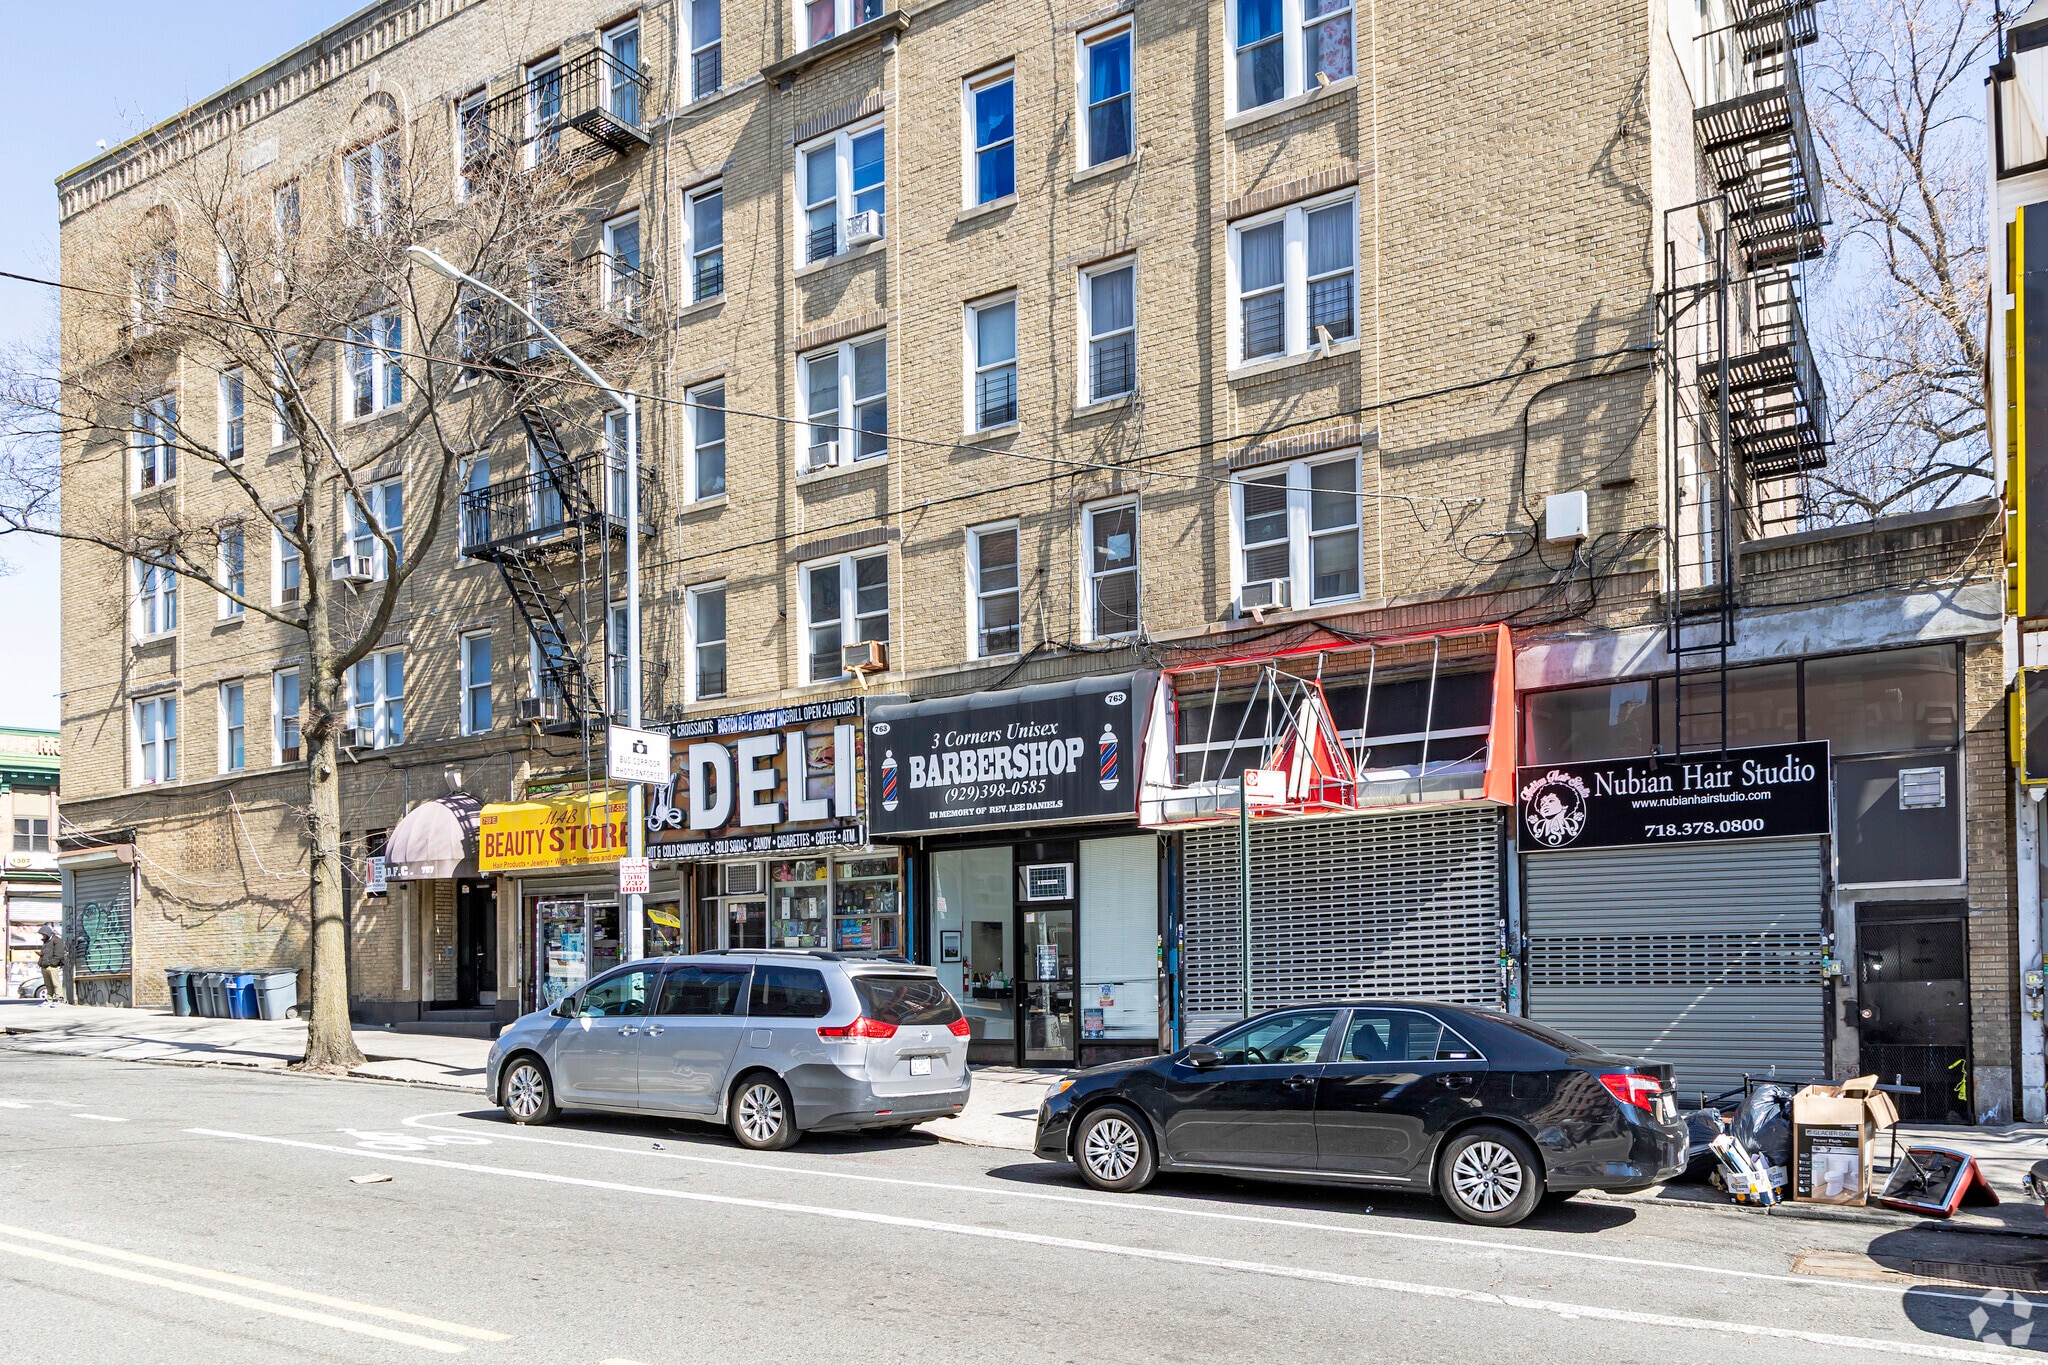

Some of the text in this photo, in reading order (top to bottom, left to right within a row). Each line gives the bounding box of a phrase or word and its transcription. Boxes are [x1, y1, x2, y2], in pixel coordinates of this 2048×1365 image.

[1108, 693, 1123, 703] 763
[804, 705, 821, 720] OPEN
[822, 703, 832, 718] 24
[832, 700, 855, 716] HOURS
[676, 720, 714, 737] CROISSANTS
[717, 717, 738, 734] BOSTON
[753, 712, 776, 730] GROCERY
[874, 724, 888, 733] 763
[931, 721, 1058, 749] 3 Corners Unisex
[619, 755, 660, 768] BUS CORRIDOR
[909, 737, 1085, 789] BARBERSHOP
[616, 766, 664, 780] PHOTO ENFORCED
[688, 723, 857, 830] DELI
[1594, 754, 1816, 797] Nubian Hair Studio
[944, 779, 1046, 804] (929)398-0585
[1631, 789, 1772, 809] www.nubianhairstudio.com
[540, 808, 578, 826] MAB
[929, 800, 1063, 819] IN MEMORY OF REV. LEE DANIELS
[1644, 818, 1765, 838] 718.378.0800
[485, 829, 545, 858] BEAUTY
[646, 828, 856, 858] HOT & COLD SANDWICHES COLD SODAS CANDY CIGARETTES COFFEE ATM
[504, 860, 526, 868] Products
[530, 859, 549, 868] Jewelry
[554, 857, 568, 866] Wigs
[572, 854, 600, 864] Cosmetics
[601, 854, 612, 862] and
